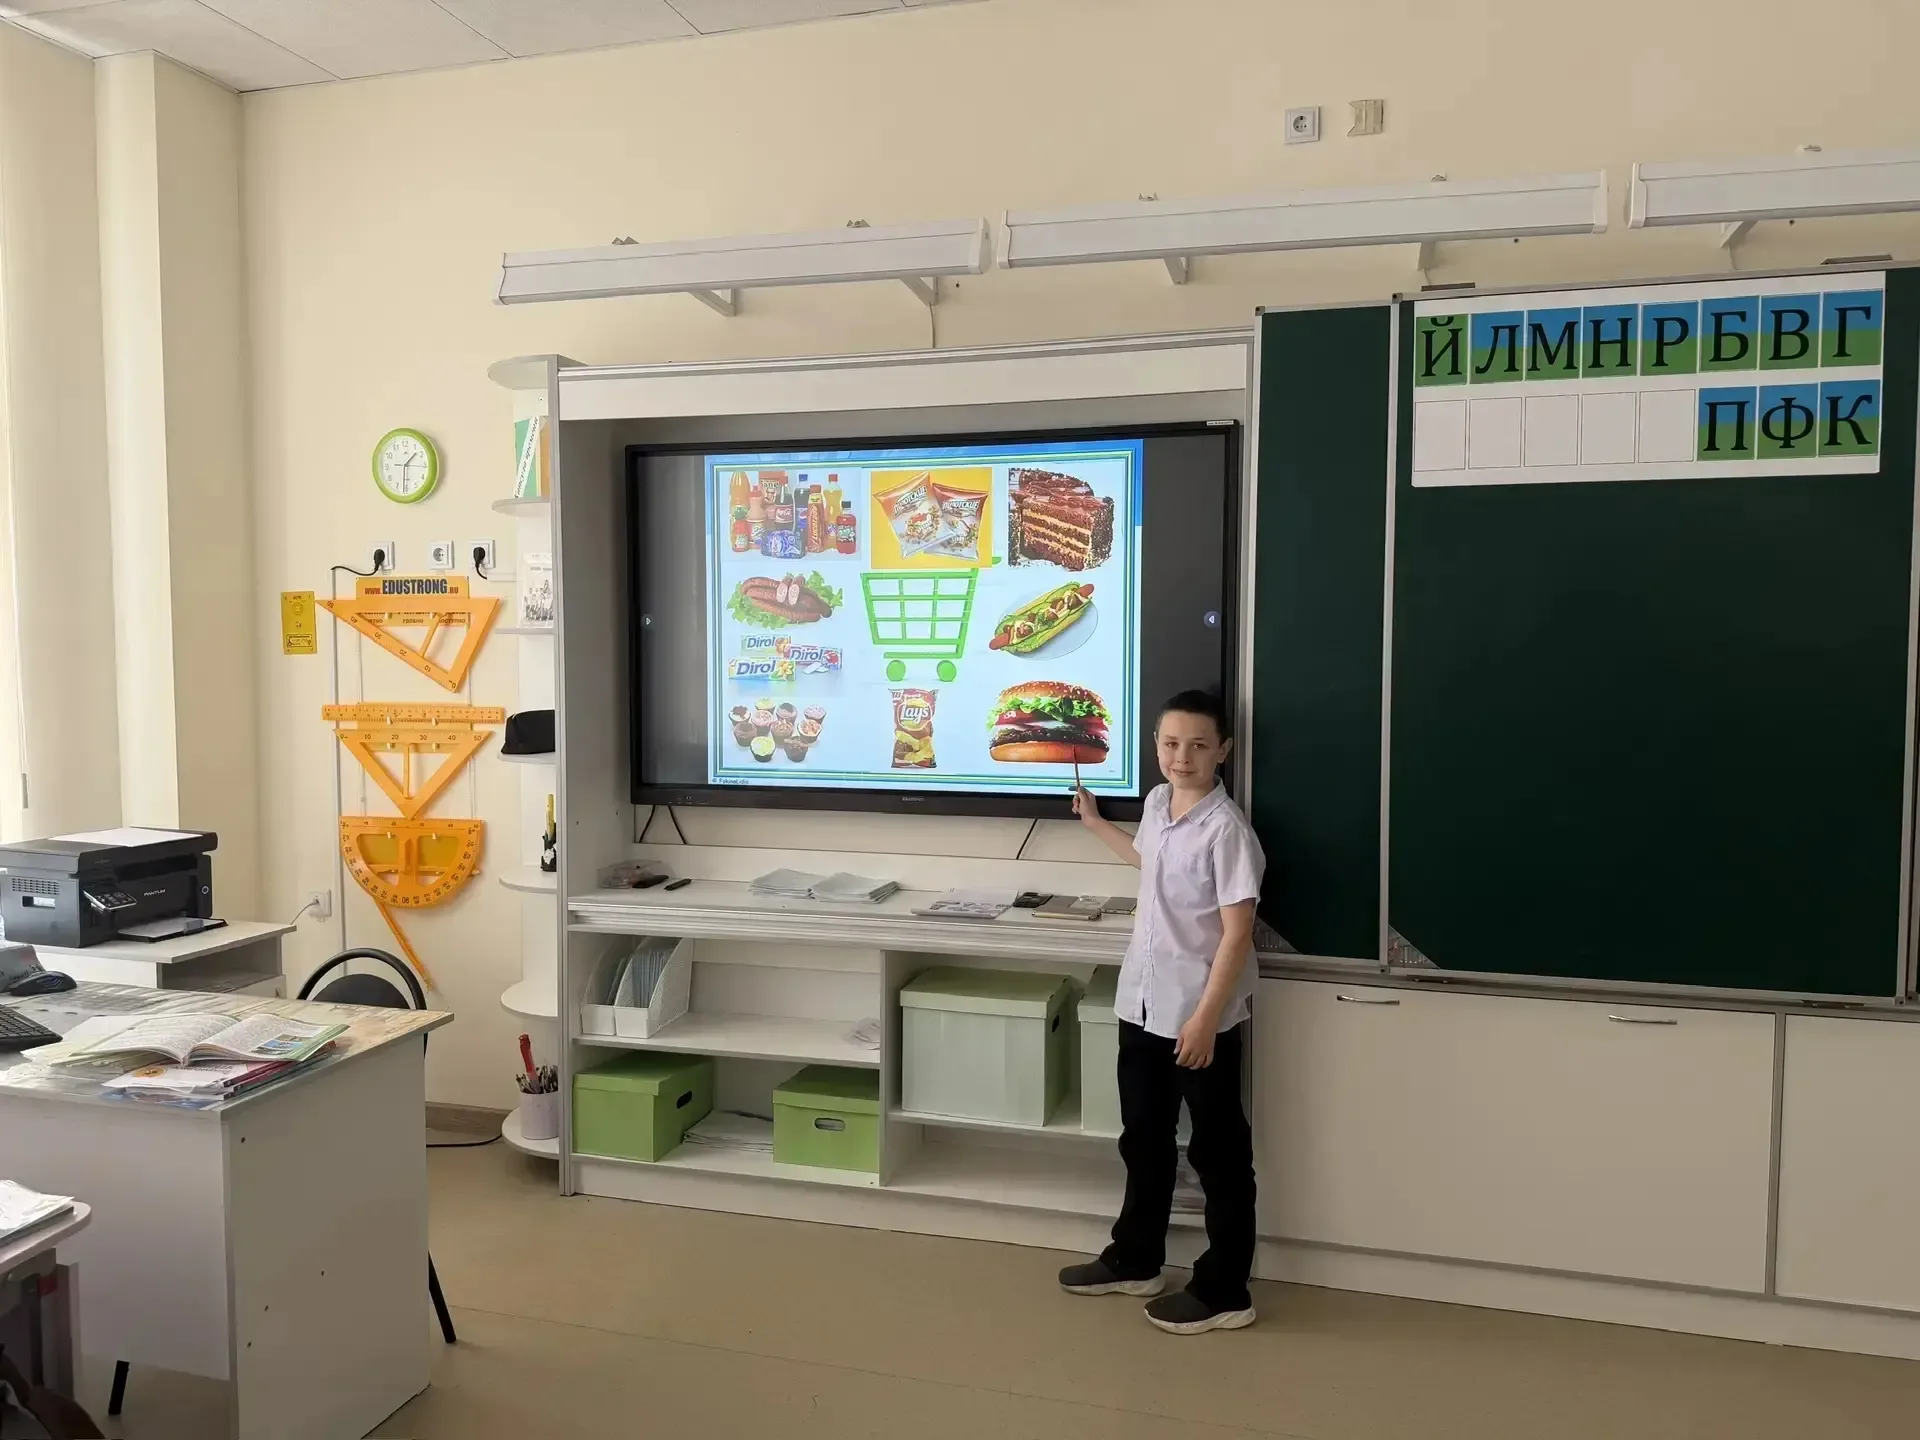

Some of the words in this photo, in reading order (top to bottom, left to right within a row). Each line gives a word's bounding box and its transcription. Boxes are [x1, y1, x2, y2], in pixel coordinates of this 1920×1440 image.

[1420, 316, 1463, 377] Й
[1475, 324, 1521, 375] Л
[1527, 320, 1579, 372] М
[1588, 317, 1633, 369] Н
[1651, 315, 1690, 367] Р
[1708, 310, 1750, 363] Б
[1769, 308, 1811, 360] В
[1832, 305, 1873, 358] Г
[1703, 400, 1750, 452] П
[1761, 396, 1815, 449] Ф
[1824, 394, 1874, 446] К
[746, 636, 776, 648] Dirol
[789, 649, 823, 661] Dirol
[736, 660, 777, 676] Dirol
[143, 888, 166, 897] PANTUM
